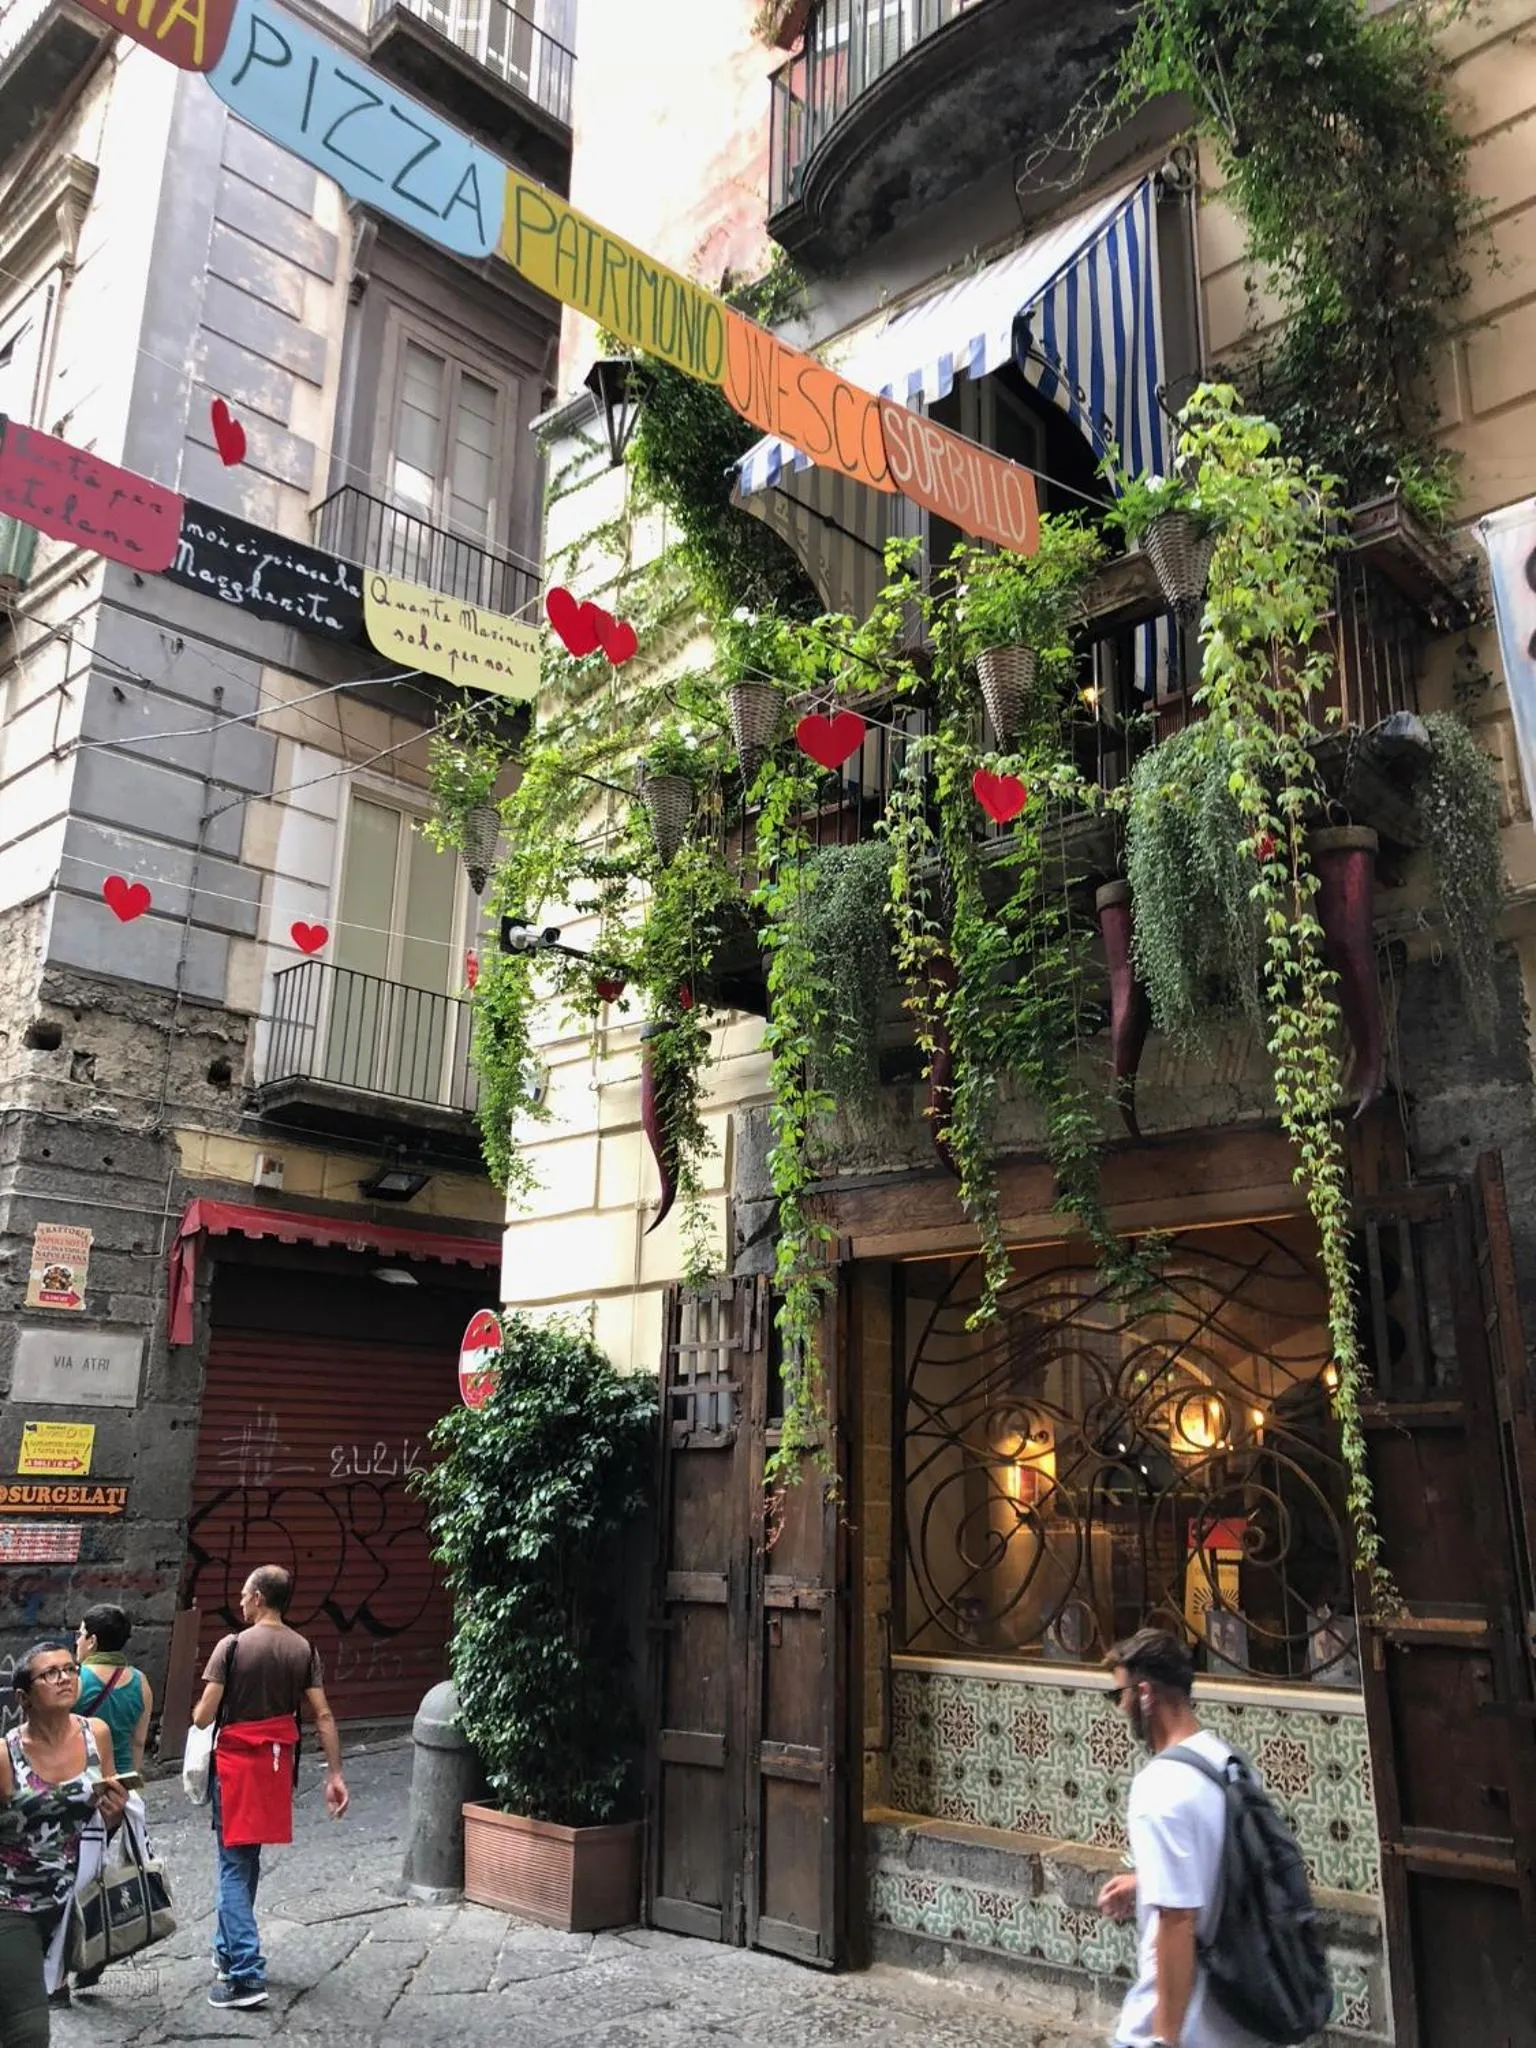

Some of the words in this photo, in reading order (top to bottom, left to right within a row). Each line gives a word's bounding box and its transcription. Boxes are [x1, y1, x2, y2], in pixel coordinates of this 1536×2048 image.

[231, 14, 487, 246] PIZZA
[514, 185, 723, 381] PATRIMONIO
[726, 316, 892, 482] UNESCO
[882, 406, 1027, 544] SORBILLO
[371, 576, 452, 623] Quante
[393, 623, 442, 651] solo
[54, 1355, 73, 1369] VIA
[82, 1357, 110, 1371] ATRI
